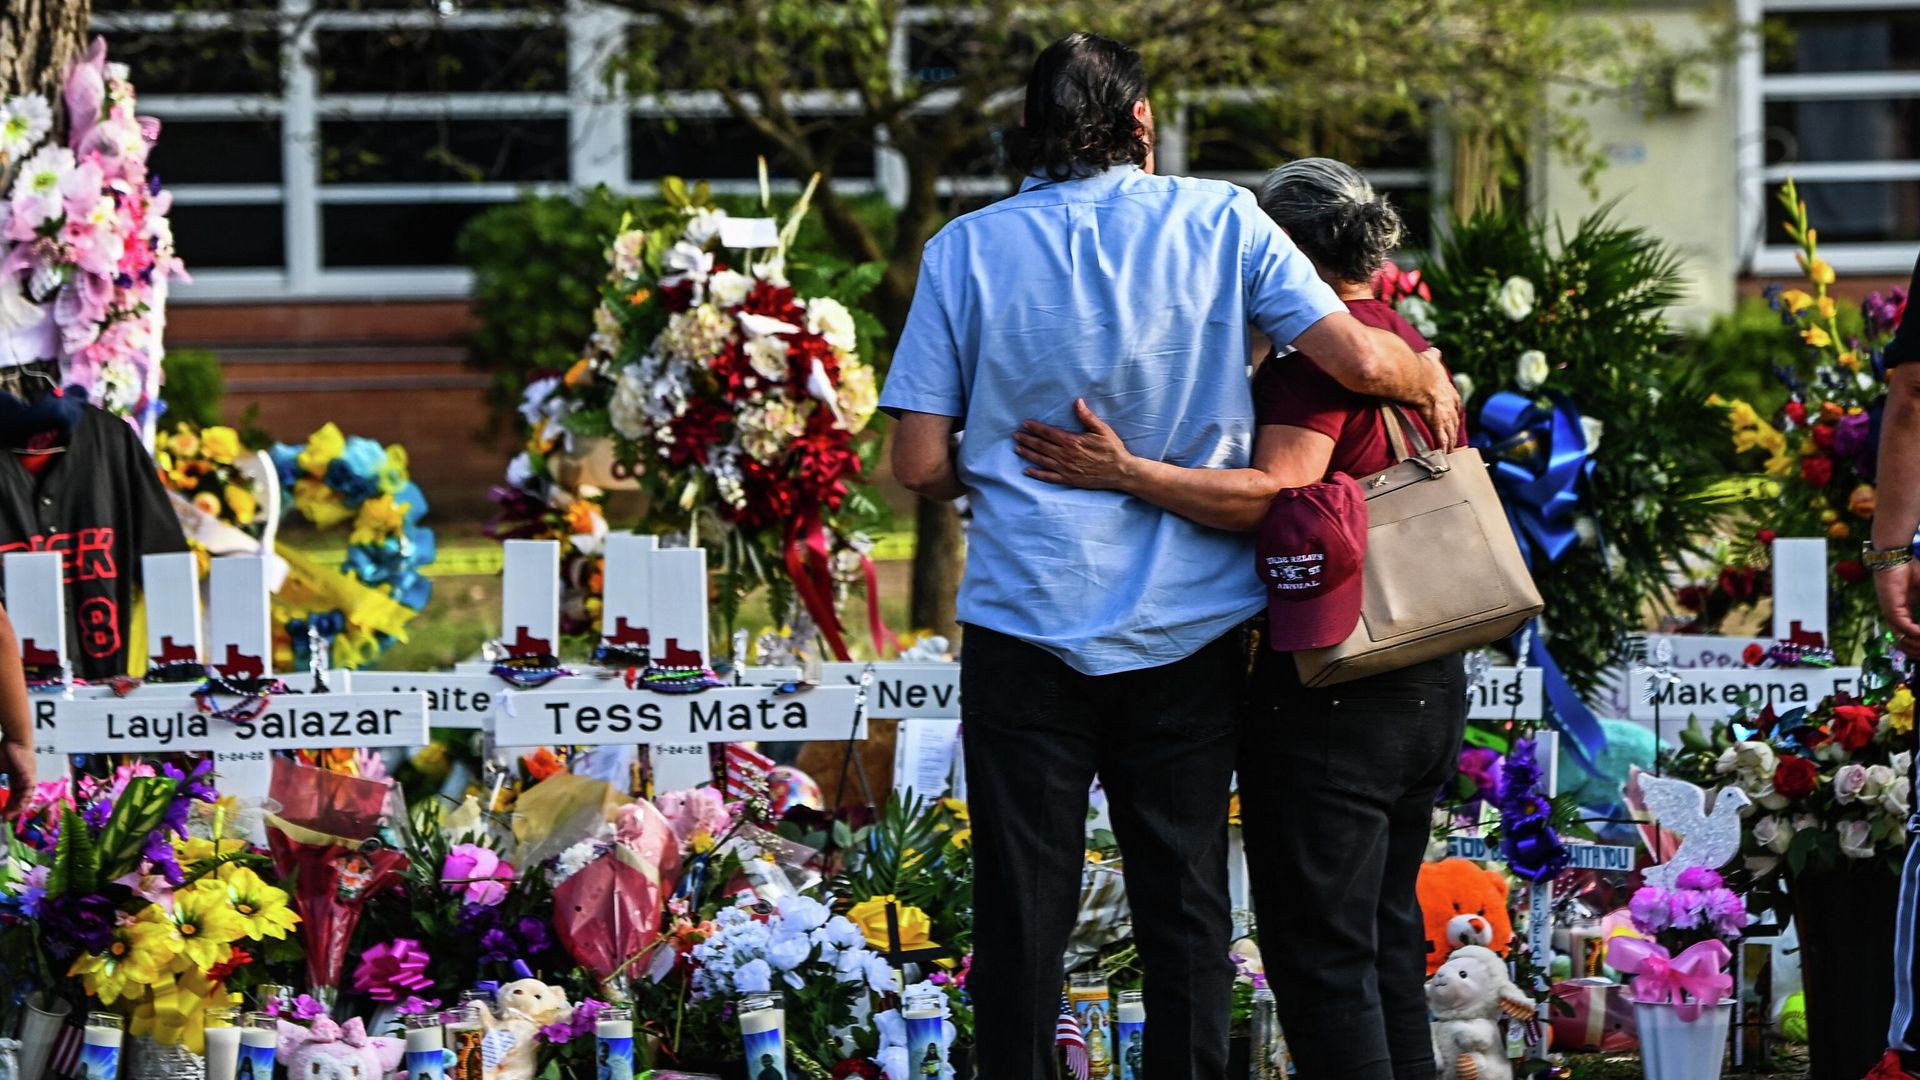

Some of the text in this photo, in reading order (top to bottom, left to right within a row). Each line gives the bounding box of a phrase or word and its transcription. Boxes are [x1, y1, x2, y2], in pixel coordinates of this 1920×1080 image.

[79, 596, 122, 658] 8
[878, 680, 960, 709] Nev
[1650, 679, 1808, 707] Makenna
[106, 708, 403, 745] Layla Salazar
[545, 699, 808, 734] Tess Mata
[218, 752, 265, 762] 5-24-22
[1447, 836, 1486, 858] GOD
[1601, 846, 1630, 870] YOU
